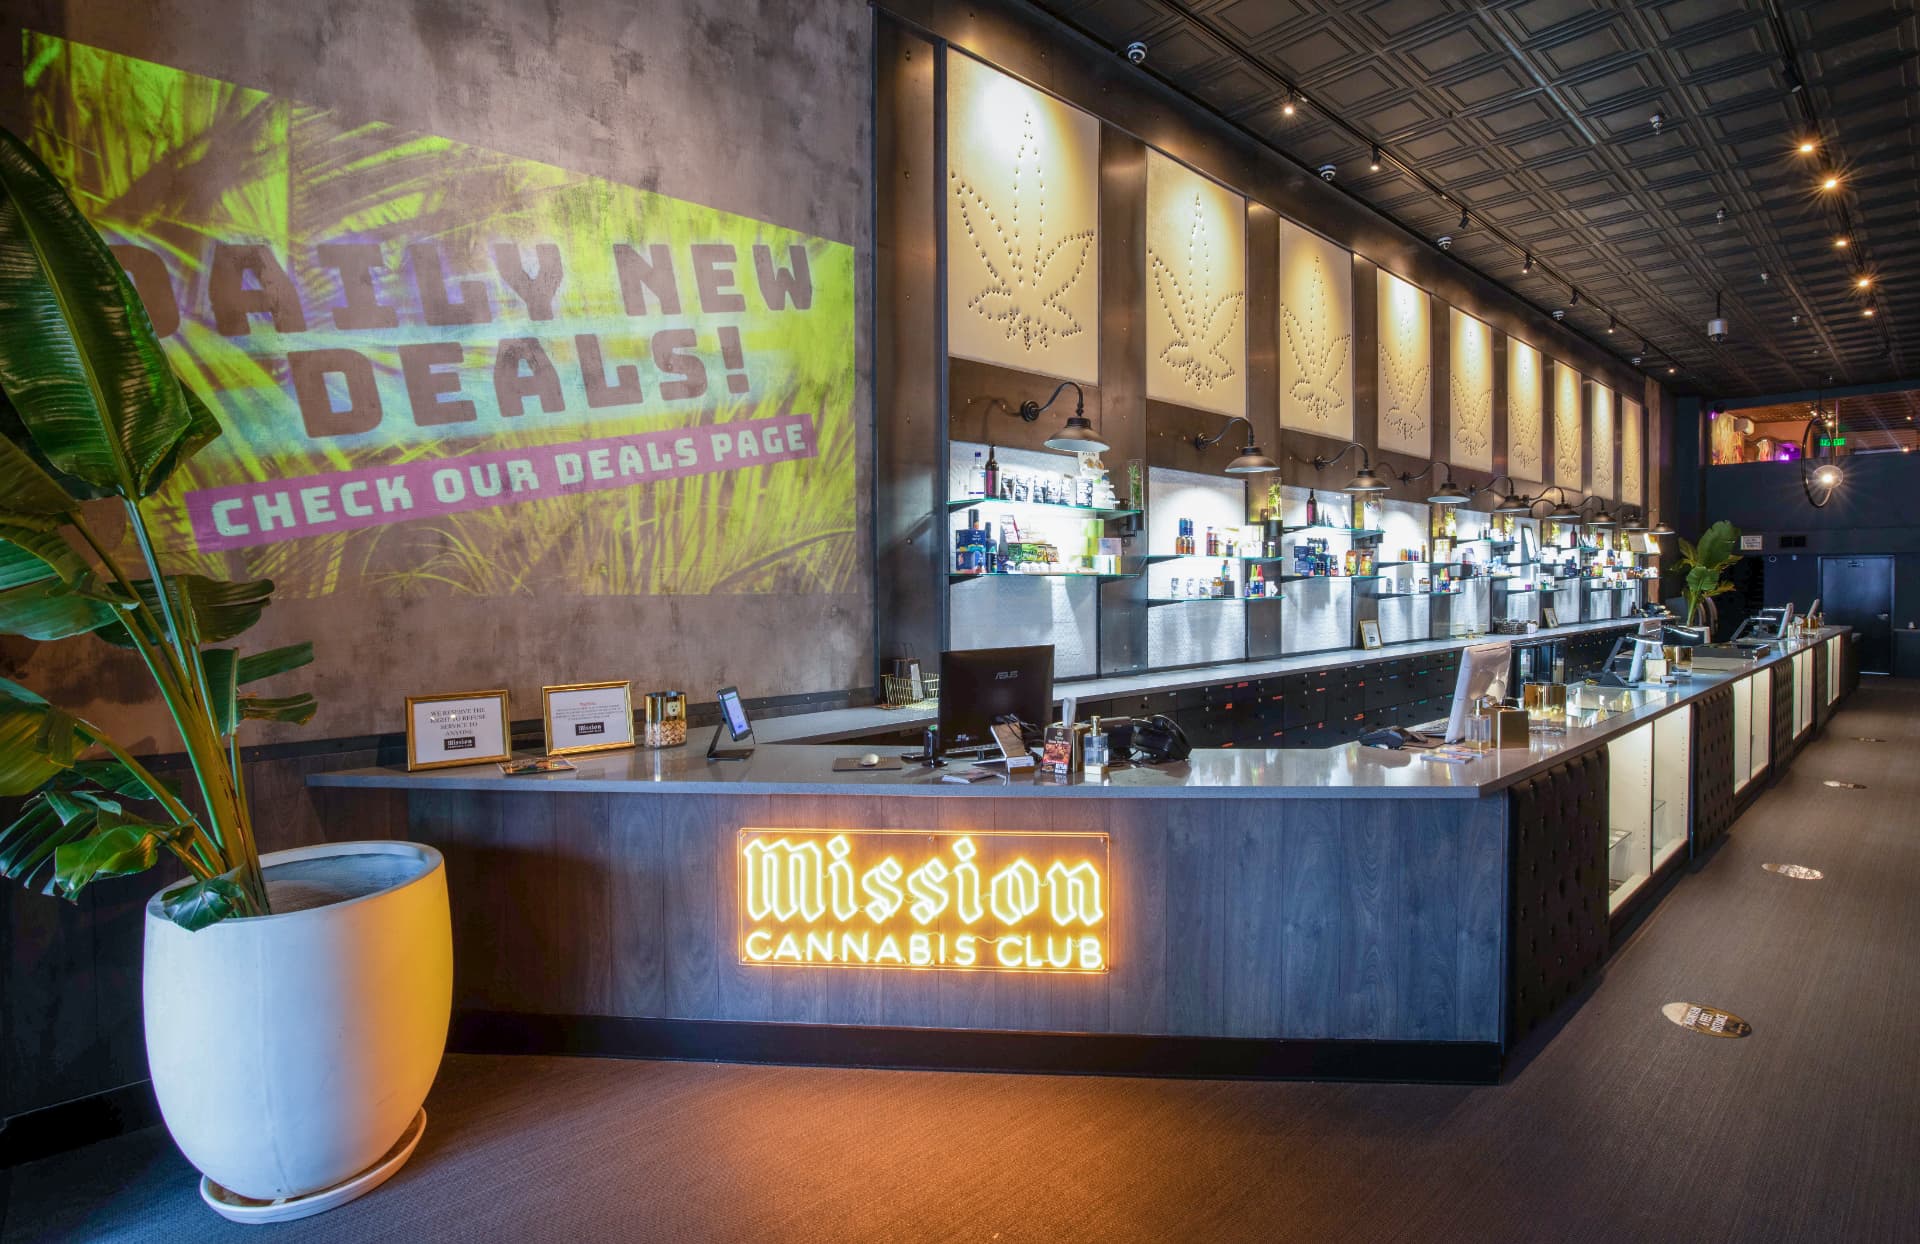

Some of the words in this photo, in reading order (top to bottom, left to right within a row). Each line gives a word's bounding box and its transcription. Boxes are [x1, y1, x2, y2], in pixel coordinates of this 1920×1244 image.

[612, 243, 813, 318] NEW
[287, 326, 751, 439] DEALS!
[211, 475, 414, 537] CHECK
[433, 458, 539, 504] OUR
[556, 437, 699, 486] DEALS
[713, 424, 808, 462] PAGE
[995, 670, 1018, 680] ASUS
[743, 834, 1104, 926] Mission
[745, 931, 977, 966] CANNABIS
[996, 935, 1103, 969] CLUB
